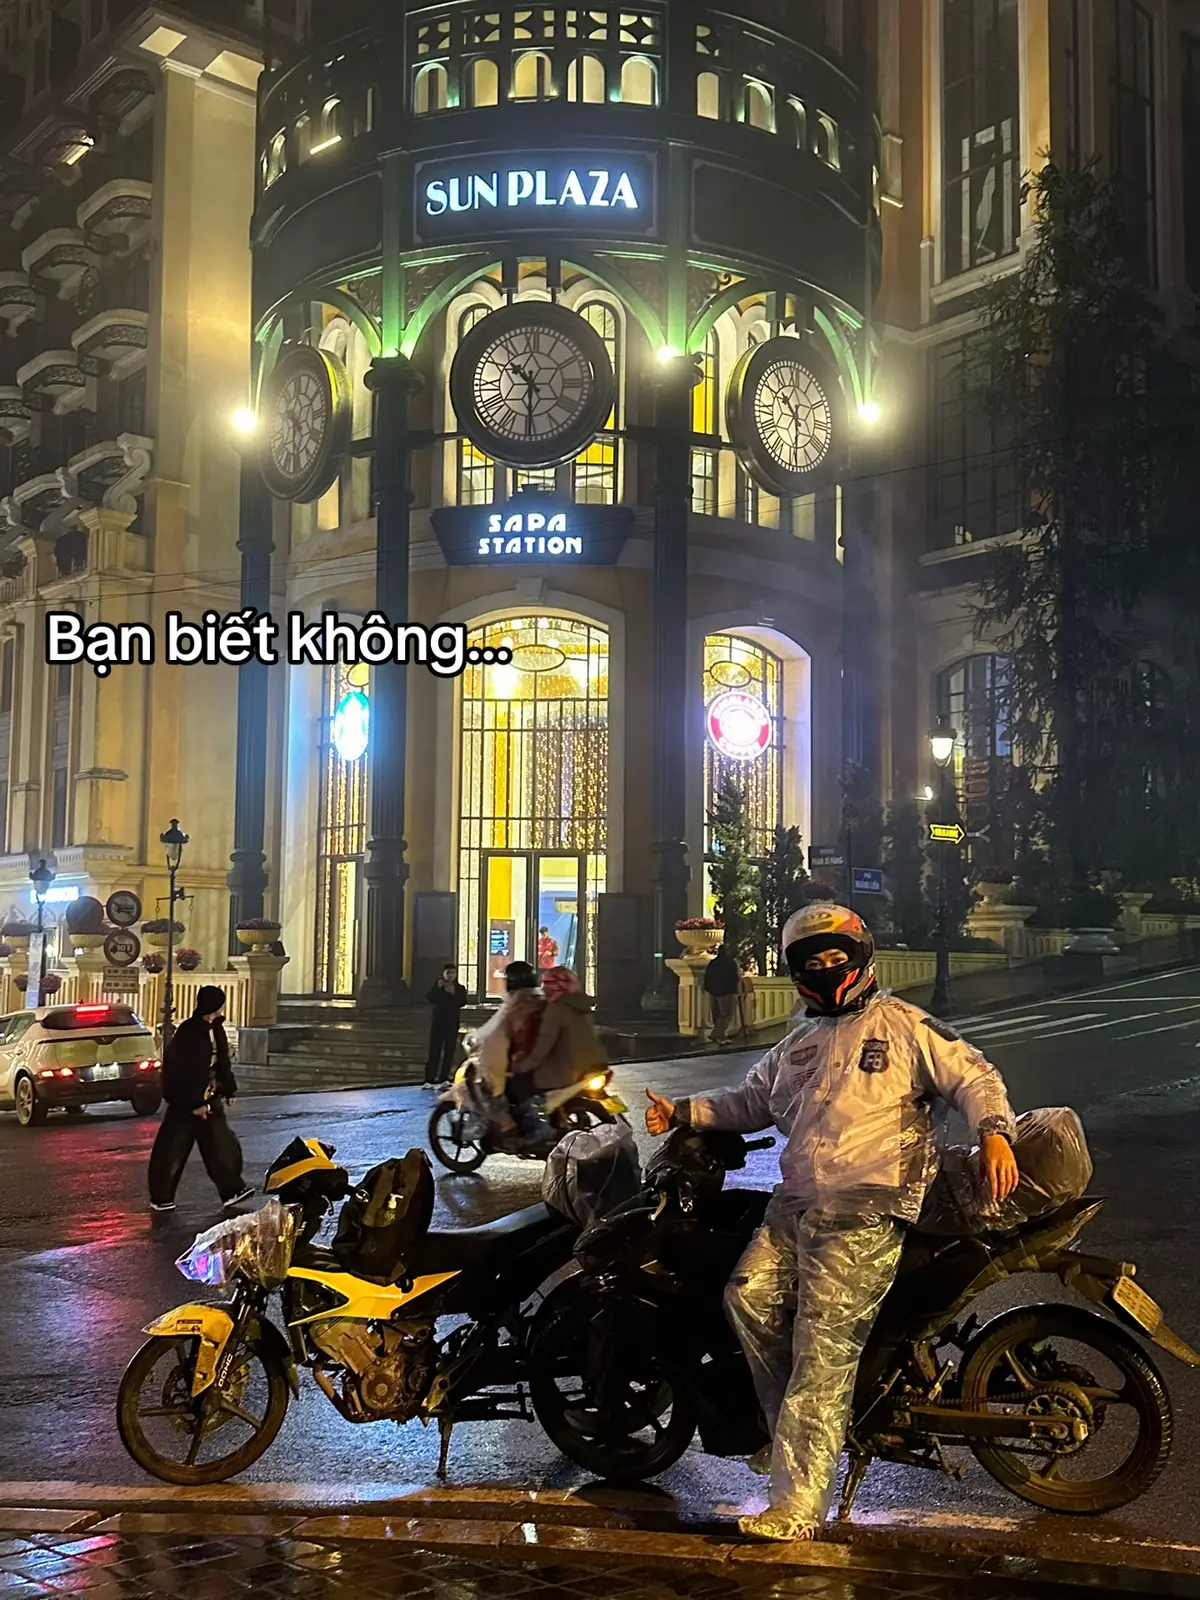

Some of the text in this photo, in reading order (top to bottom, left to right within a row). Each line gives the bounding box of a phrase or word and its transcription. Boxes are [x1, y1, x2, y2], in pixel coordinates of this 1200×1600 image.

[425, 169, 639, 216] SUN PLAZA
[488, 512, 567, 533] SAPA
[477, 536, 583, 555] STATION
